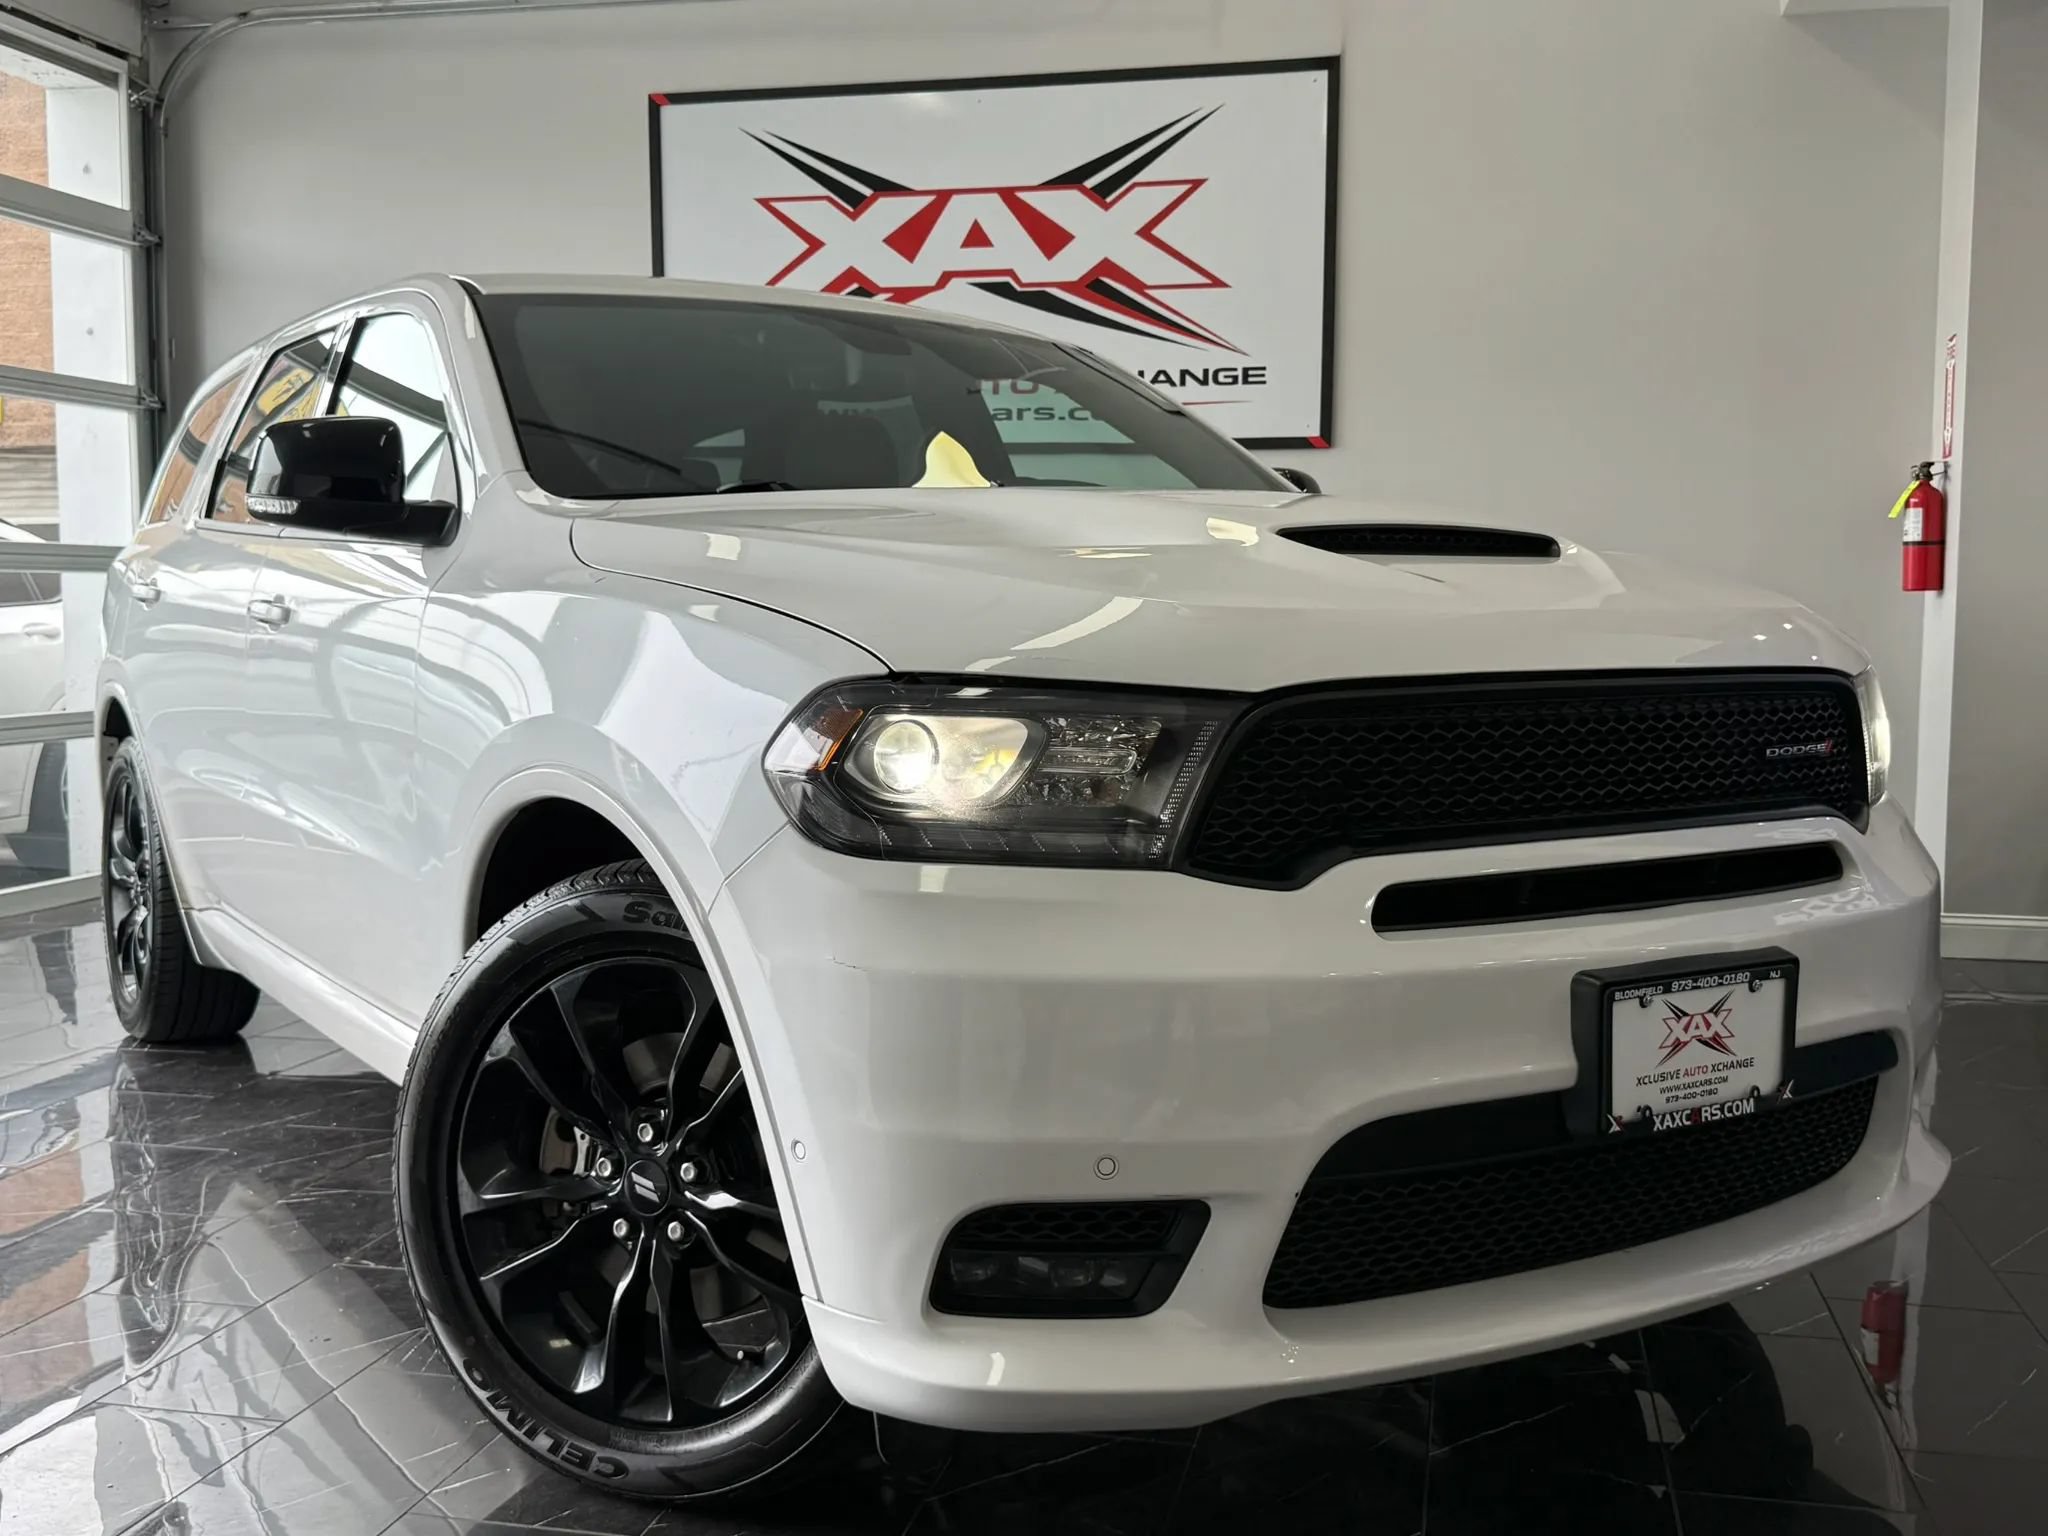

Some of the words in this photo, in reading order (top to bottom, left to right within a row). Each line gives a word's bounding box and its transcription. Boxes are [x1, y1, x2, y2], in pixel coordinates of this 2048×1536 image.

[754, 178, 1231, 291] XAX
[1138, 366, 1267, 387] ANGE
[1766, 743, 1826, 757] DODGE
[1614, 985, 1664, 1001] BLOOMFIELD
[1670, 971, 1751, 992] 973-400-0180
[1658, 1008, 1735, 1049] XAX
[1636, 1069, 1681, 1087] XCLUSIVE
[1682, 1064, 1709, 1079] AUTO
[1710, 1057, 1755, 1073] XCHANGE
[1659, 1075, 1729, 1095] WWW.XAXCARS.COM
[1665, 1087, 1719, 1104] 973-400-0180
[1652, 1097, 1756, 1132] XAXCARS.COM
